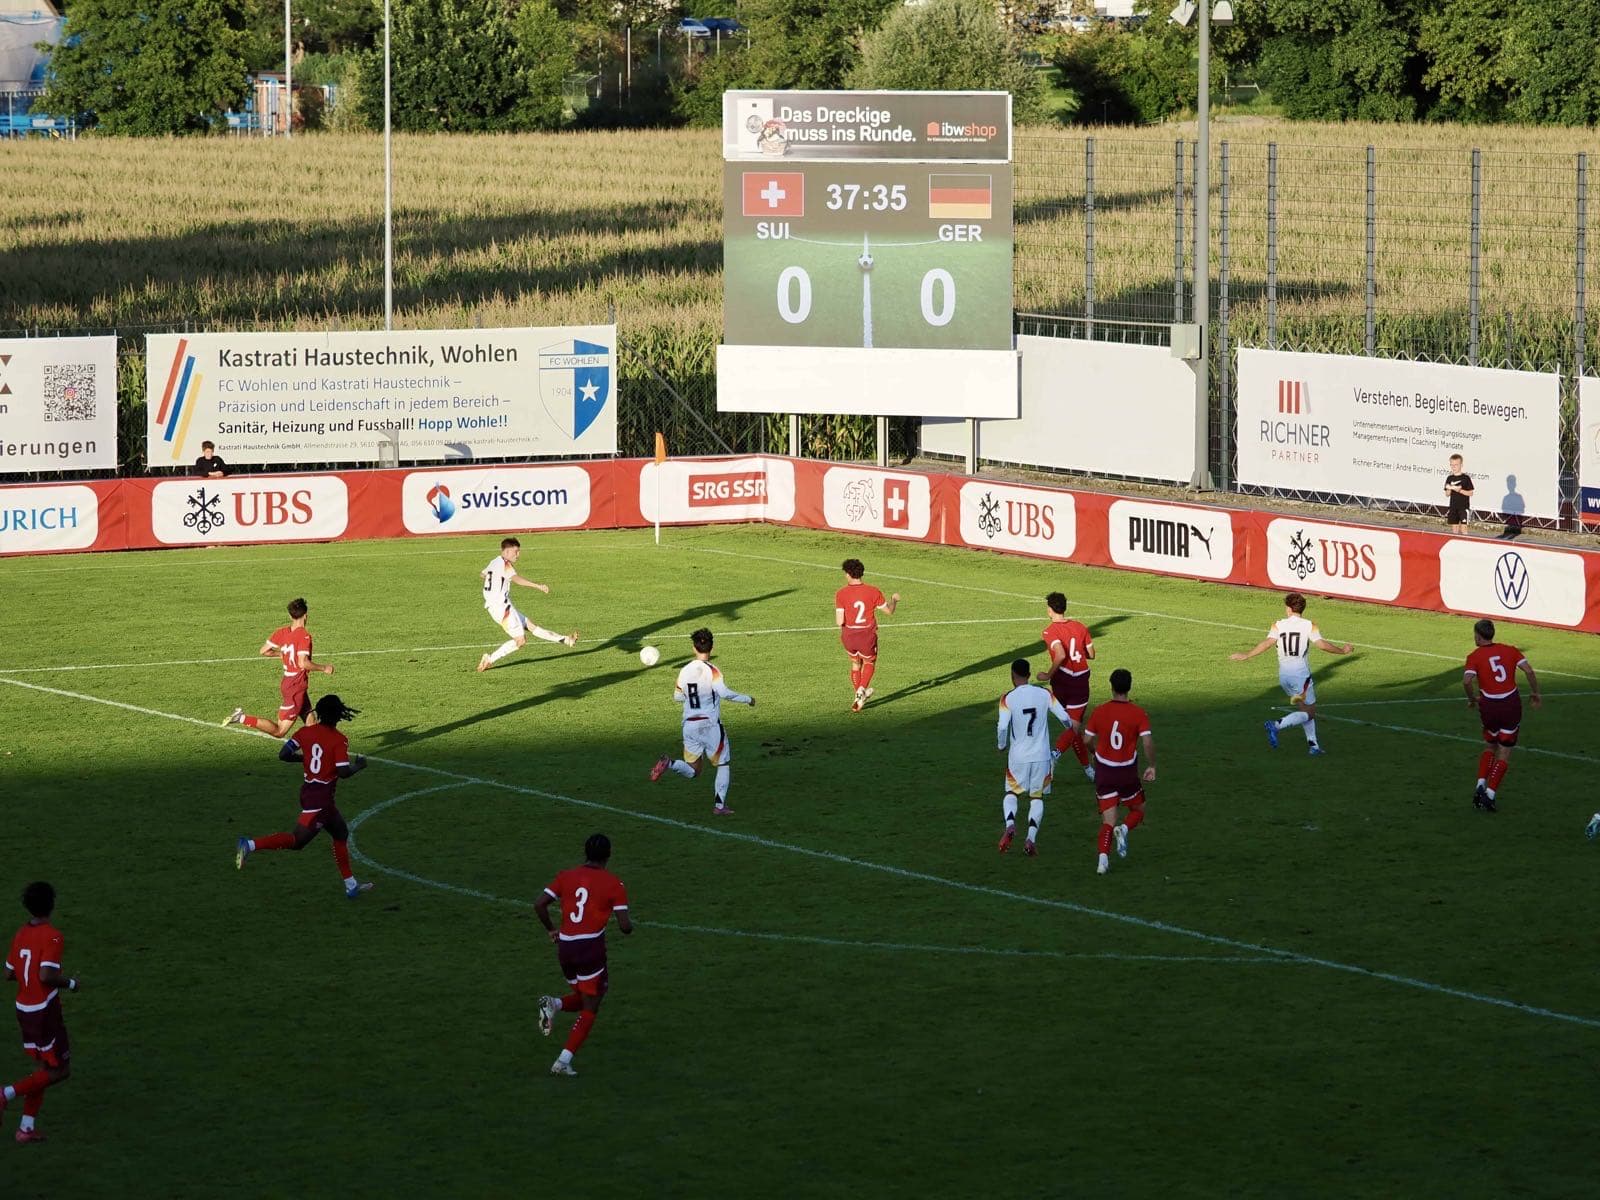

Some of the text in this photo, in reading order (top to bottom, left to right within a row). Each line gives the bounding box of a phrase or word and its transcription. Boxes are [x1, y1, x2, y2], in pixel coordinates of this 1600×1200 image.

[781, 106, 890, 127] Das Dreckige
[784, 125, 917, 142] muss ins Runde.
[942, 122, 997, 140] ibwshop
[826, 184, 907, 211] 37:35
[757, 222, 790, 240] SUI
[938, 225, 982, 242] GER
[777, 266, 812, 324] 0
[920, 268, 956, 327] 0
[218, 344, 518, 368] Kastrati Haustechnik, Wohlen
[563, 357, 600, 365] WOHLEN
[218, 380, 234, 391] FC
[238, 379, 288, 391] Wohlen
[293, 379, 317, 391] und
[321, 378, 369, 390] Kastrati
[373, 376, 450, 389] Haustechnik
[218, 400, 276, 412] Präzision
[280, 399, 305, 412] und
[310, 398, 390, 411] Leidenschaft
[394, 398, 405, 410] in
[409, 397, 448, 412] jedem
[453, 395, 499, 408] Bereich
[1353, 387, 1528, 422] Verstehen. Begleiten. Bewegen.
[218, 415, 508, 435] Sanitär, Heizung und Fussball! Hopp Wohle!!
[1260, 420, 1331, 447] RICHNER
[243, 442, 280, 450] Haustechnik
[1411, 436, 1437, 449] Coaching
[1271, 449, 1319, 463] PARTNER
[1352, 457, 1372, 468] Richner
[460, 485, 567, 509] swisscom
[692, 479, 767, 500] SRG SSR
[232, 490, 313, 527] UBS
[1005, 500, 1055, 540] UBS
[1129, 516, 1190, 558] PUMA
[1318, 539, 1376, 581] UBS
[853, 601, 866, 623] 2
[1069, 637, 1082, 663] 4
[1279, 632, 1301, 657] 10
[1488, 655, 1507, 683] 5
[687, 683, 701, 709] 8
[1022, 707, 1037, 736] 7
[1110, 720, 1123, 750] 6
[311, 743, 323, 774] 8
[570, 887, 589, 923] 3
[20, 949, 31, 988] 7
